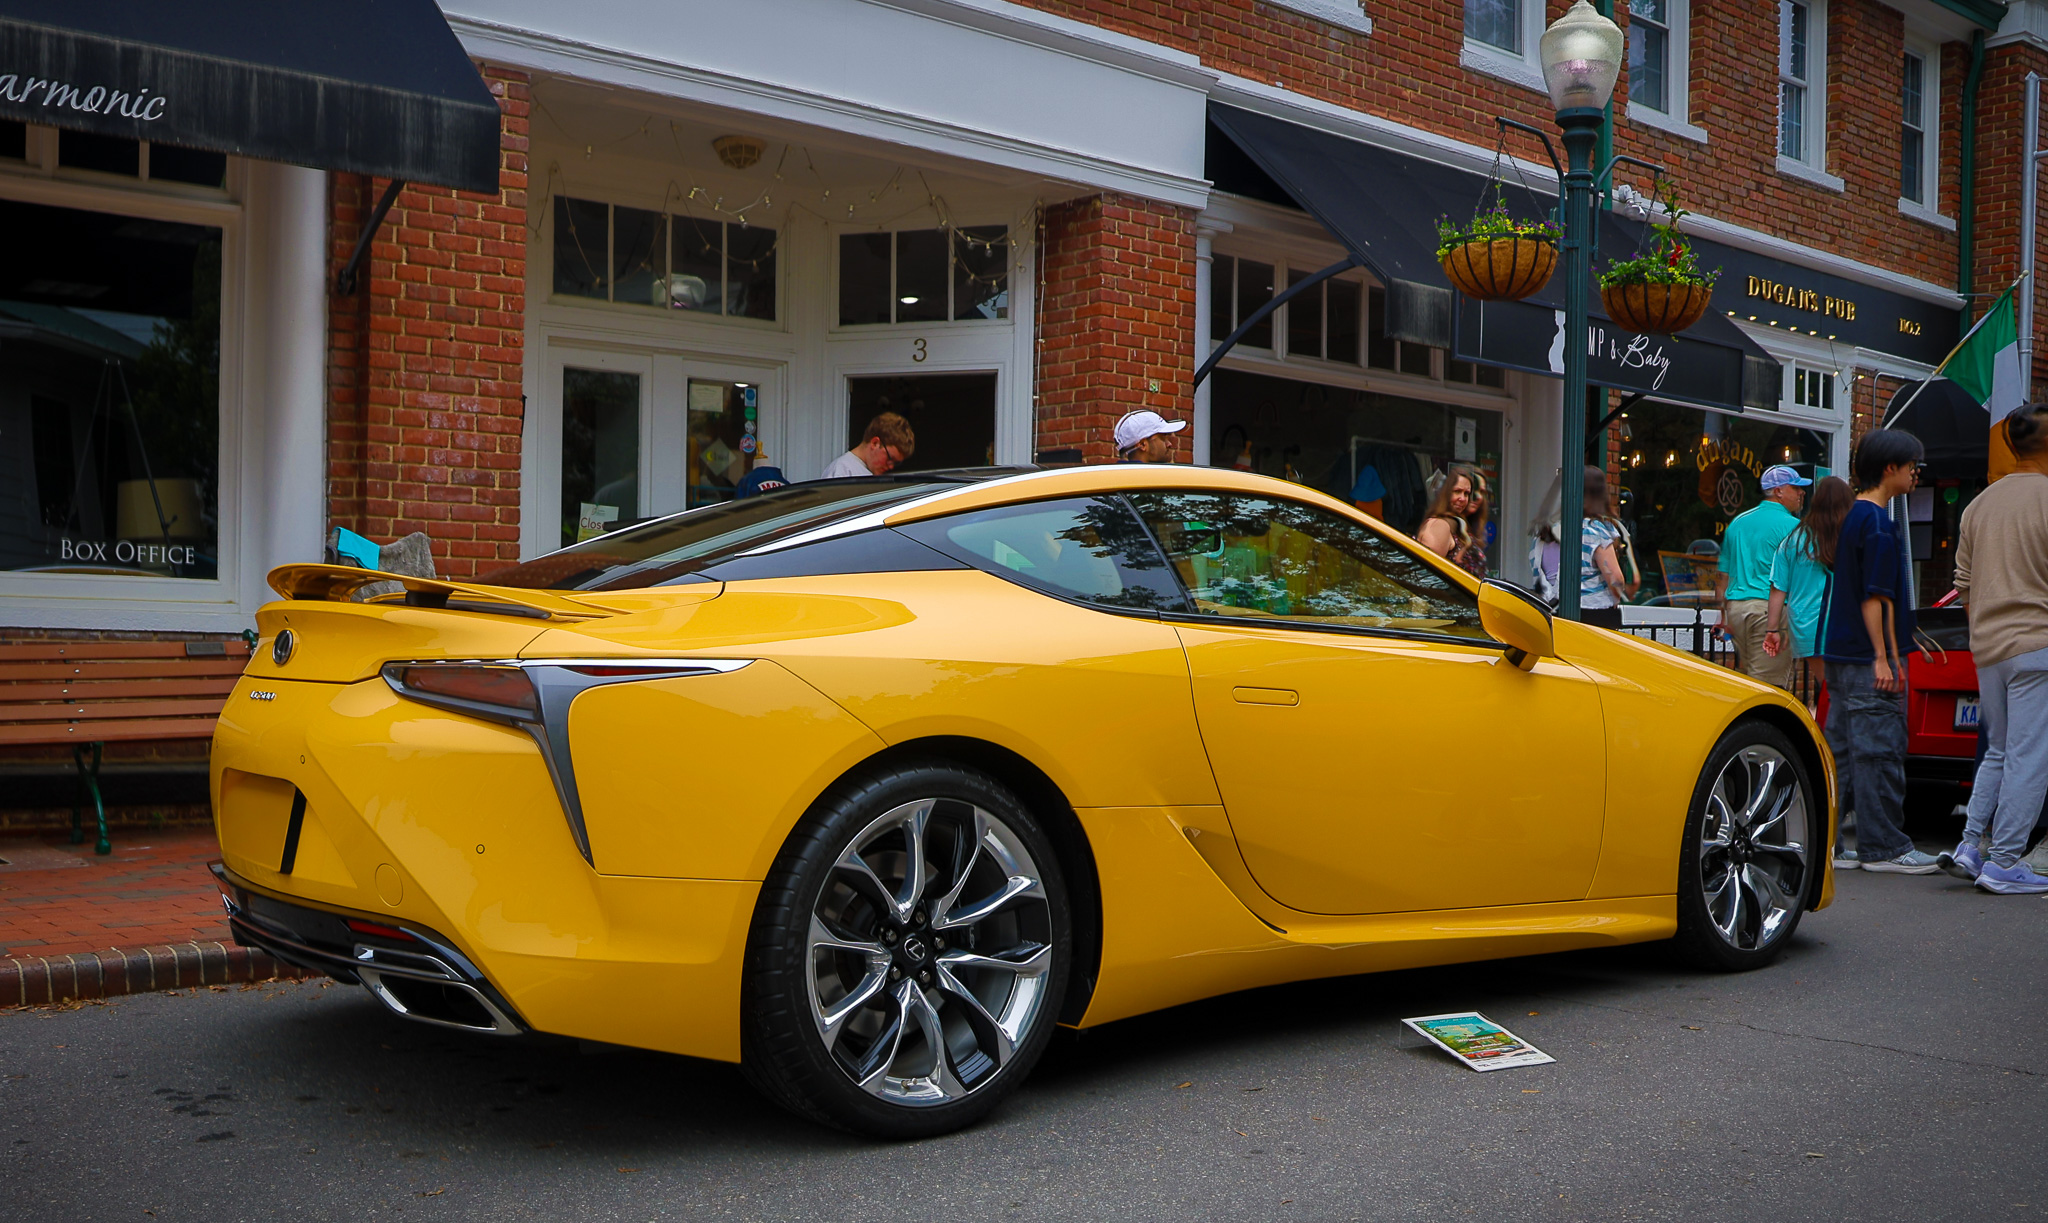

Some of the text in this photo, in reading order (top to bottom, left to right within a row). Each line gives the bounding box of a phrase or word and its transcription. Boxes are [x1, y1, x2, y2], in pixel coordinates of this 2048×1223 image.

[1748, 275, 1856, 321] DUGAN'S PUB
[1899, 317, 1921, 336] NO.2
[912, 337, 927, 362] 3
[1610, 338, 1616, 360] &
[1617, 333, 1671, 391] Baby
[1696, 437, 1763, 479] dugans
